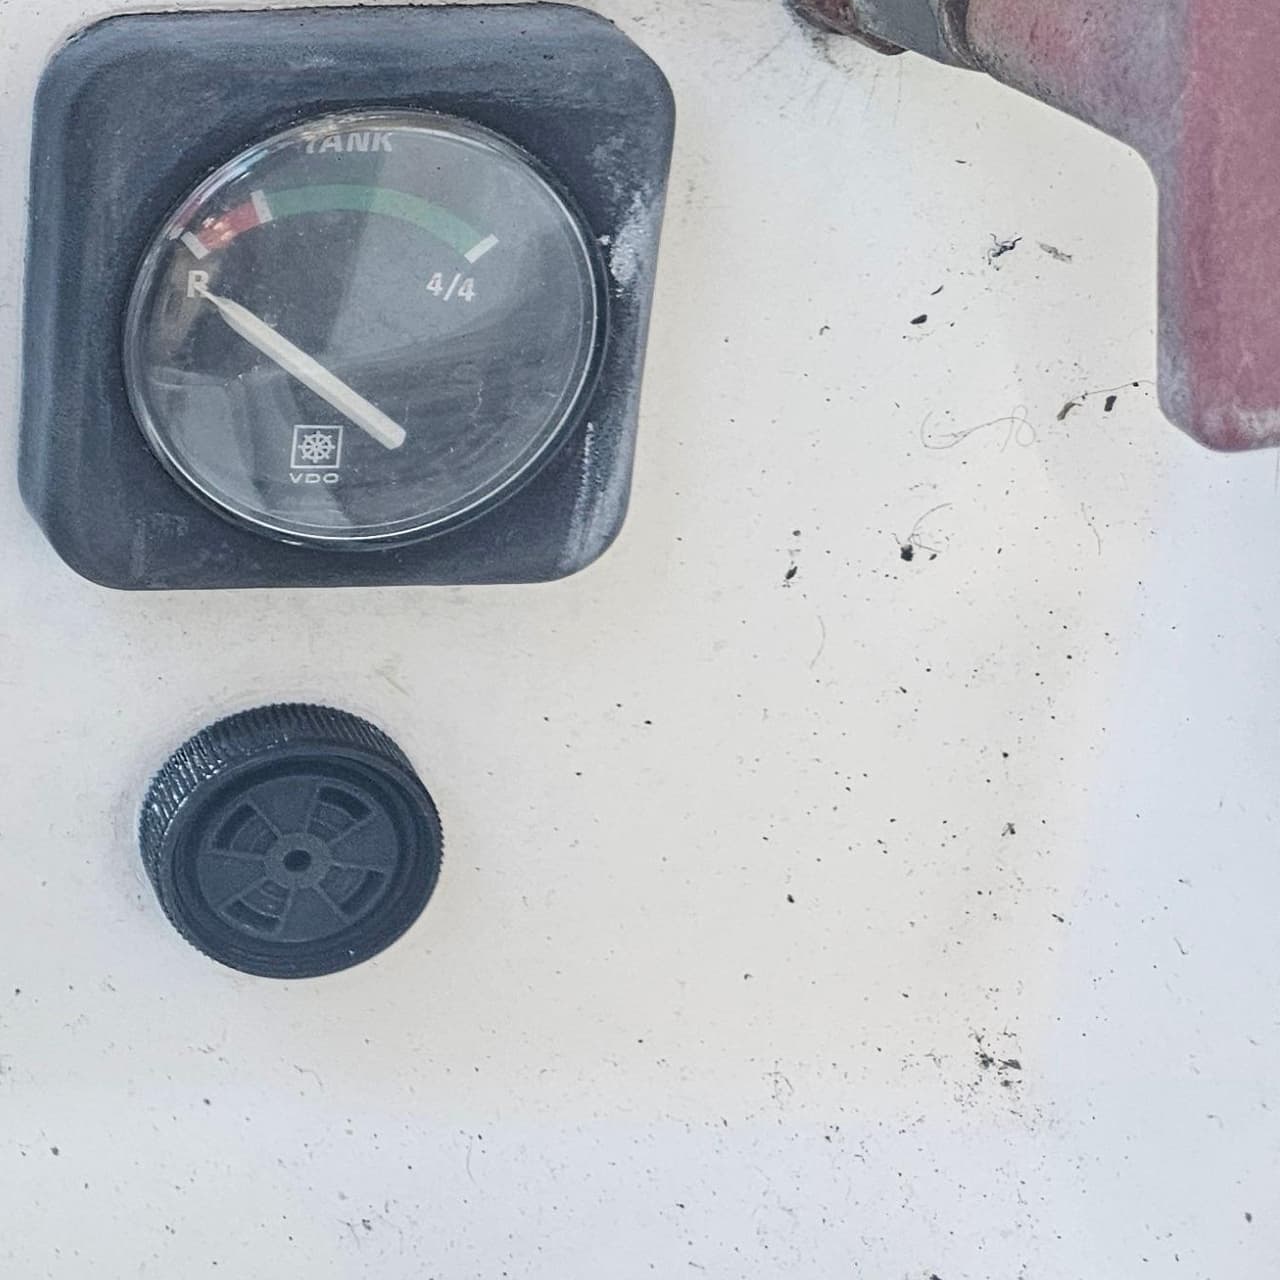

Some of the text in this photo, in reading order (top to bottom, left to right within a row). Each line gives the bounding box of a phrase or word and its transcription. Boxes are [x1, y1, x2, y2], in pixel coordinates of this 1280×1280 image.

[303, 131, 393, 153] TANK
[187, 269, 209, 298] R
[425, 272, 476, 302] 4/4
[289, 472, 340, 484] VDO
